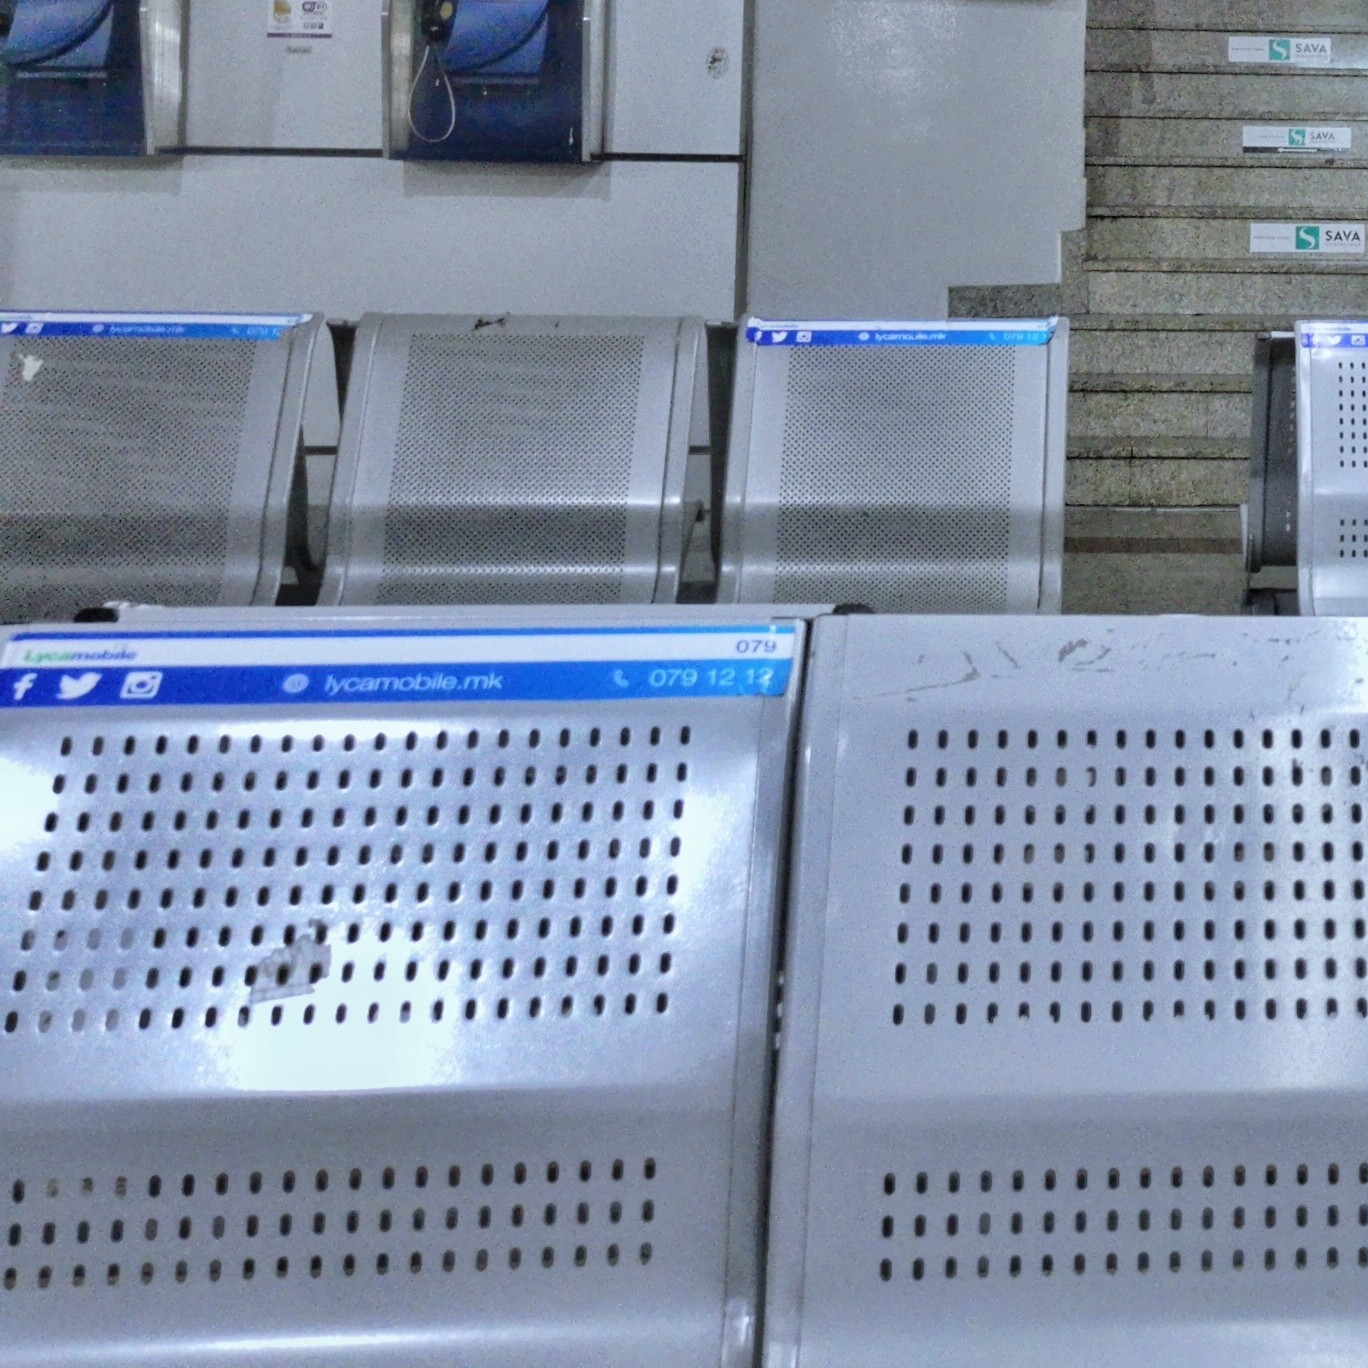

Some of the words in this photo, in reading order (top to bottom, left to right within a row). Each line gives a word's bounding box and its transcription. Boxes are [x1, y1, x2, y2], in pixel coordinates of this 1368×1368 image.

[1295, 43, 1327, 53] SAVA
[1310, 132, 1335, 141] SAVA
[1325, 230, 1361, 242] SAVA
[736, 639, 777, 654] 079
[324, 670, 502, 694] lycamobile.mk
[648, 669, 698, 687] 079
[706, 668, 735, 686] 12
